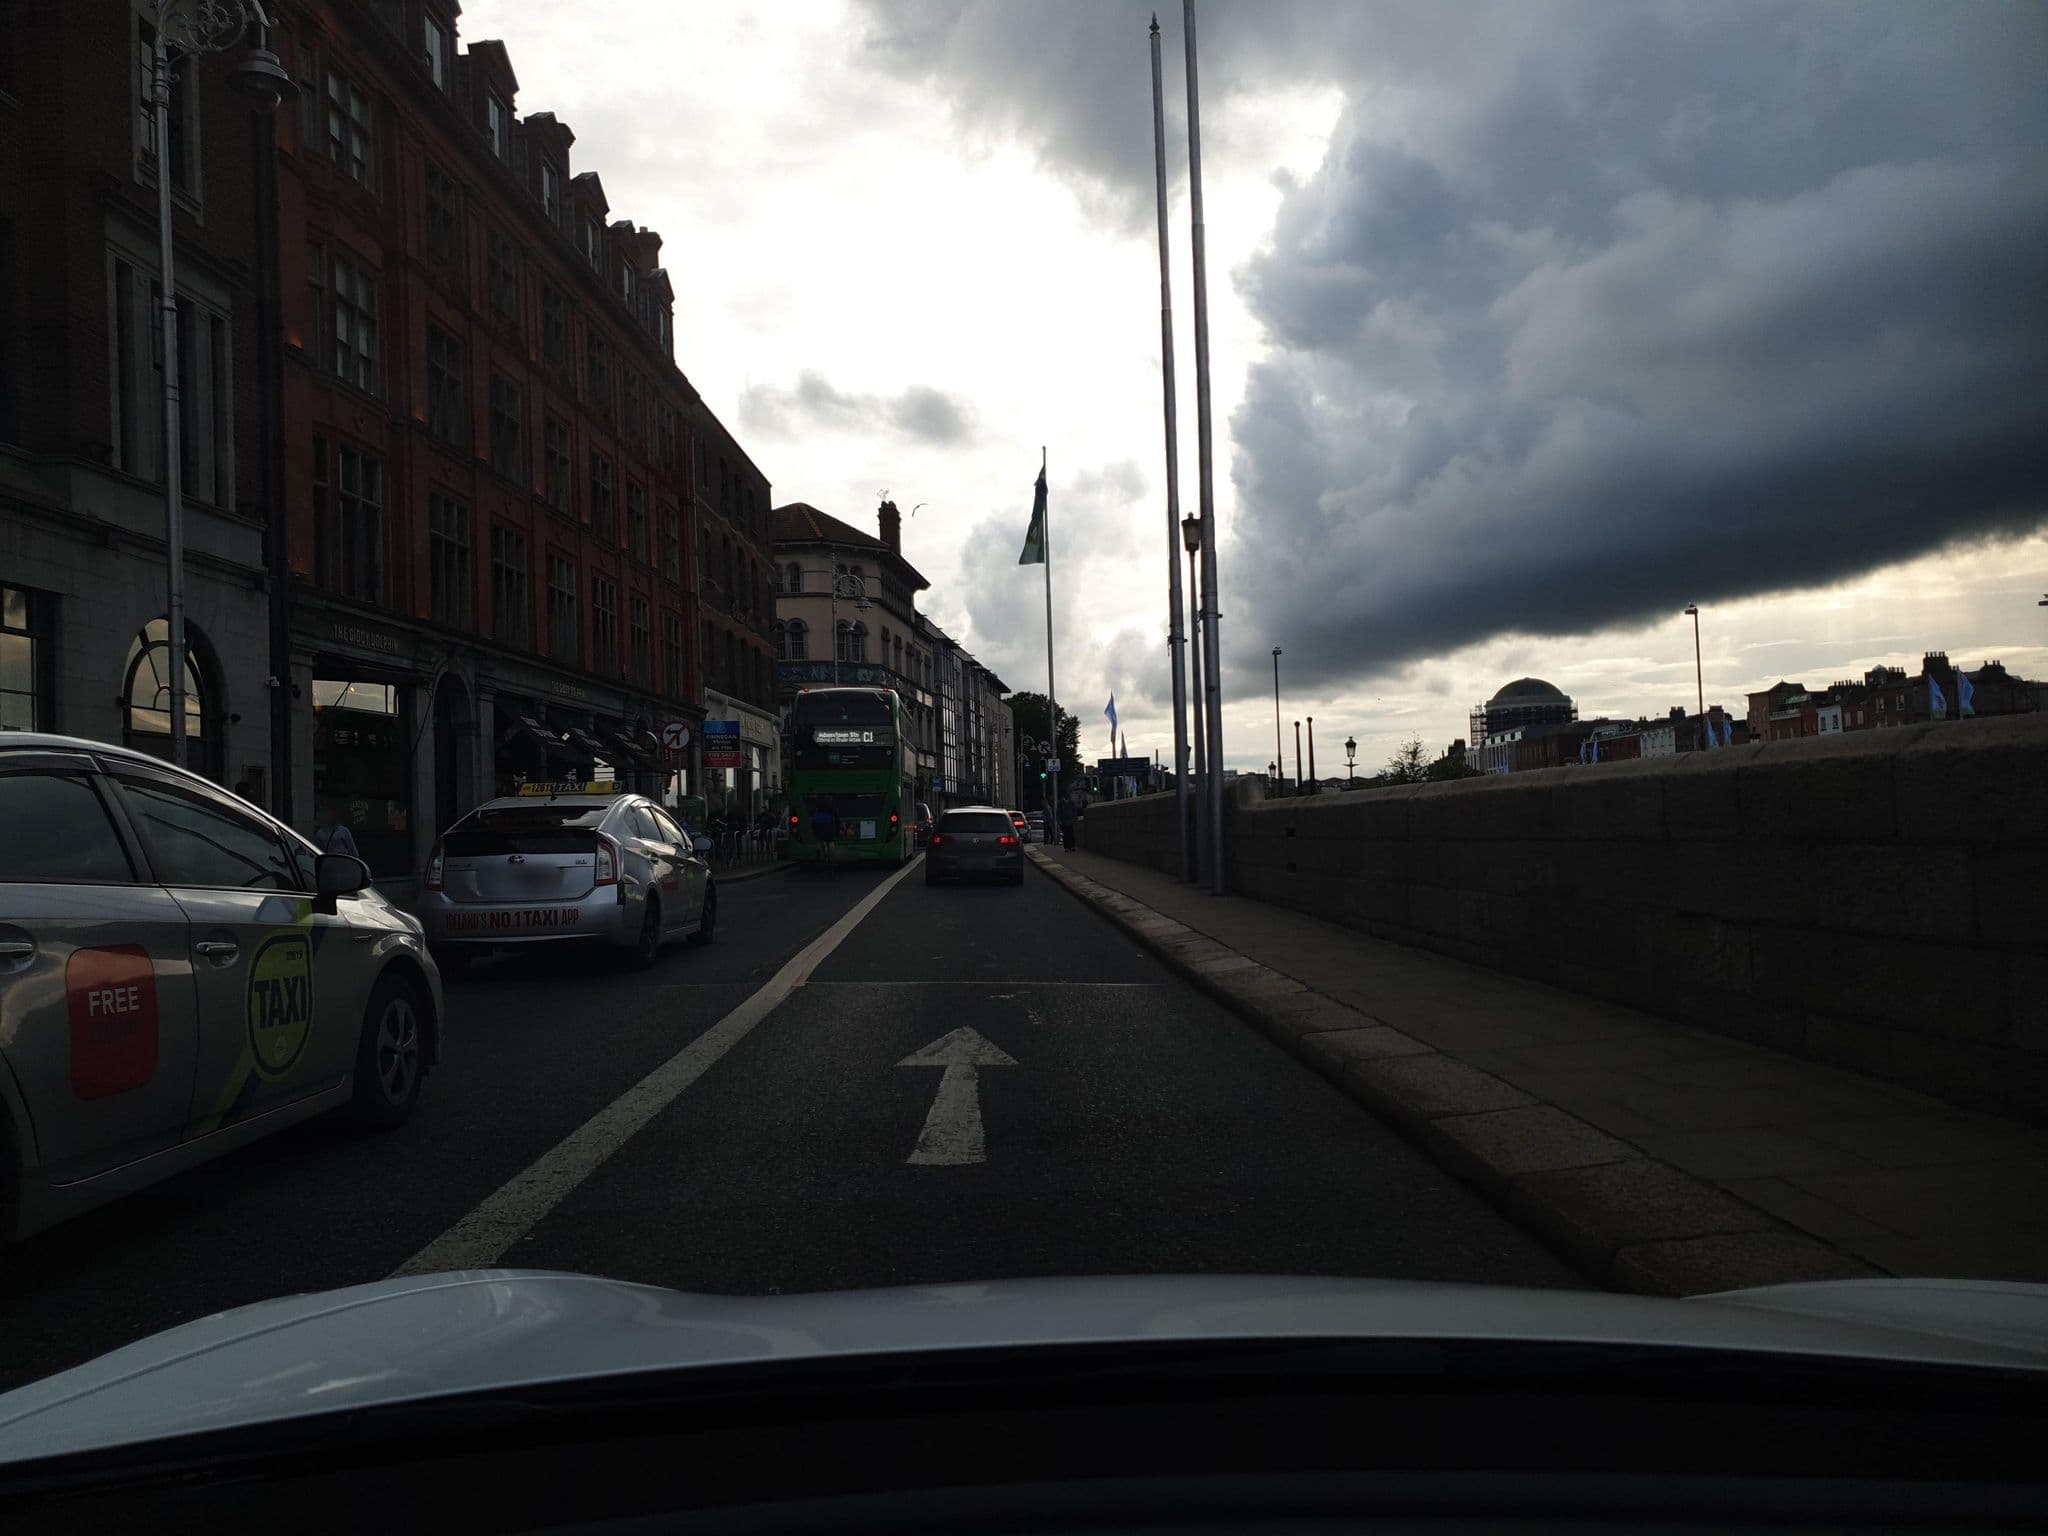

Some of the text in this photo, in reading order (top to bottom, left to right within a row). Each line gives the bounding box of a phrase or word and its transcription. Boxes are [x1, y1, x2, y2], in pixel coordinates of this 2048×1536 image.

[334, 624, 349, 641] THE
[863, 731, 873, 742] C1
[557, 782, 586, 793] TAXI
[524, 909, 559, 928] TAXI
[561, 908, 579, 926] APP
[88, 985, 140, 1017] FREE
[254, 976, 306, 1029] TAXI
